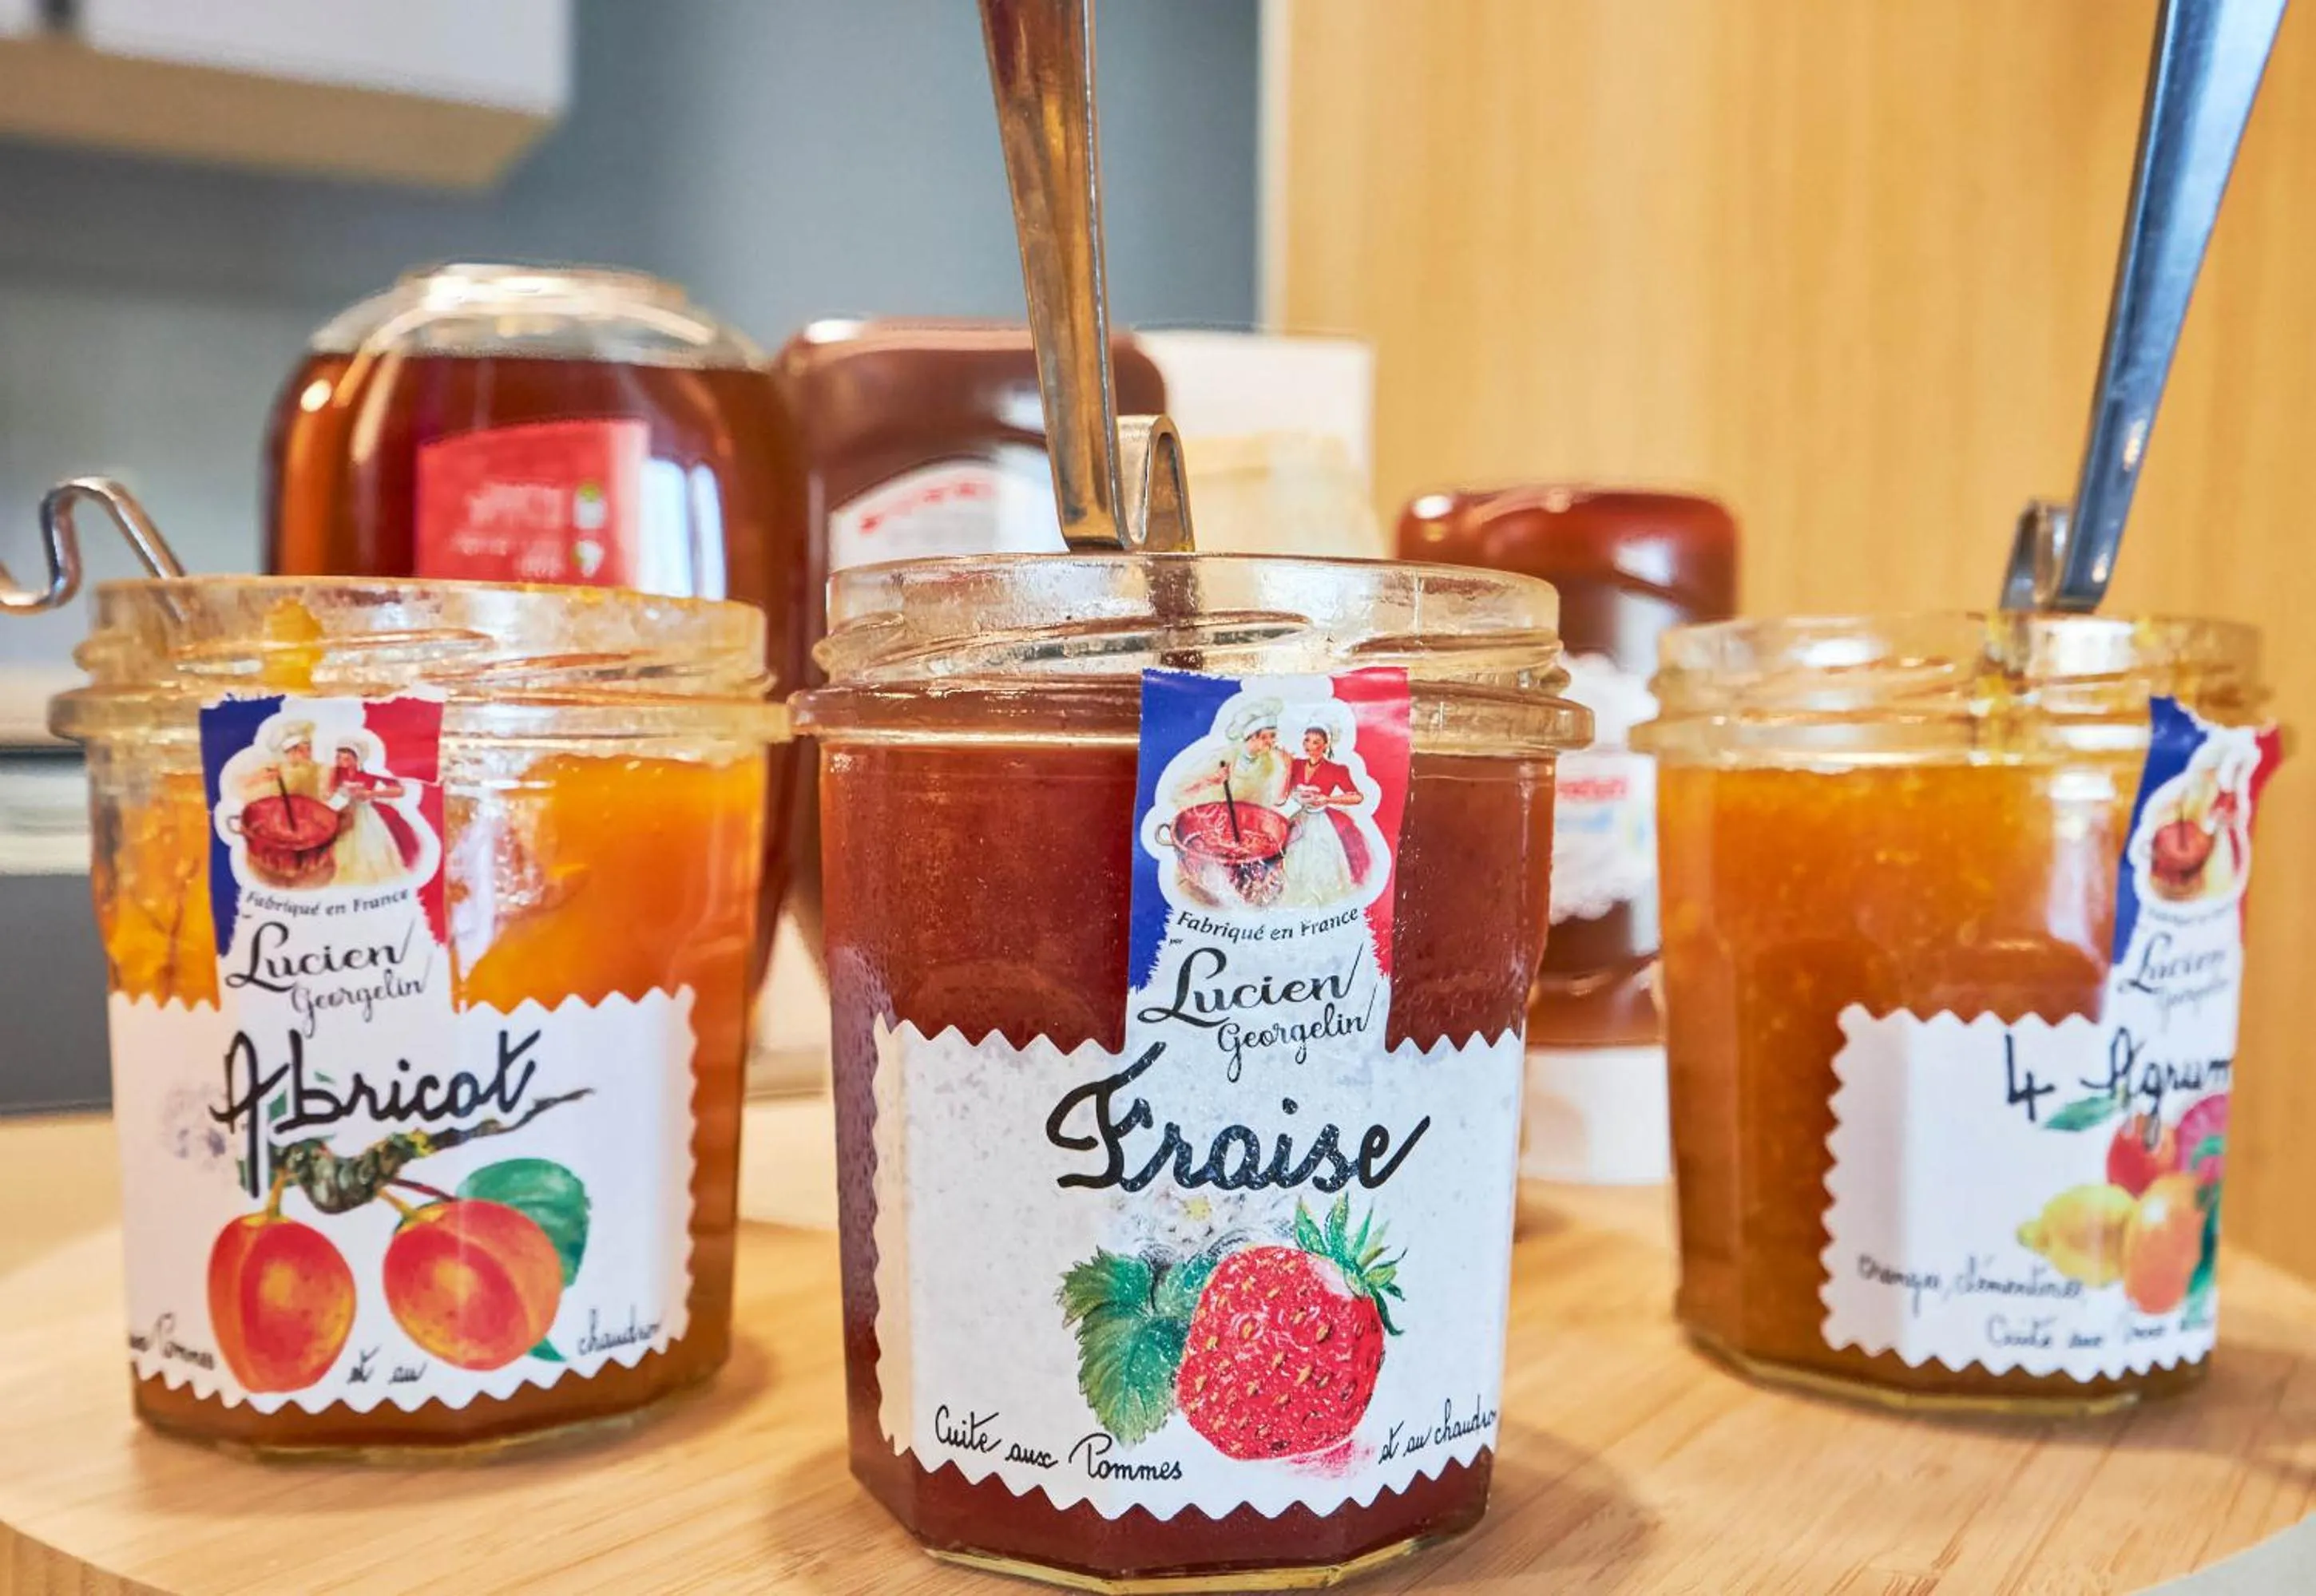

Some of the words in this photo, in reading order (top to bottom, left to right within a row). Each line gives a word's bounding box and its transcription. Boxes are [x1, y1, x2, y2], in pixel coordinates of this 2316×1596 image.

[246, 890, 321, 918] Fabriqué
[325, 904, 347, 916] en
[352, 889, 409, 913] France
[1176, 910, 1264, 944] Fabriqué
[1269, 927, 1294, 940] en
[1300, 908, 1358, 937] France
[224, 917, 416, 992] Lucien
[290, 952, 433, 1039] Georgelin
[1136, 941, 1365, 1028] Lucien
[1217, 982, 1378, 1083] Georgelin
[208, 1028, 542, 1198] Abricot
[1045, 1041, 1430, 1193] Fraise
[2005, 1032, 2056, 1123] 4
[387, 1359, 430, 1386] au
[934, 1404, 1002, 1453] Cuite
[1004, 1442, 1059, 1469] aux
[1067, 1432, 1184, 1481] Pommes
[1378, 1420, 1405, 1466] et
[1402, 1425, 1433, 1458] au
